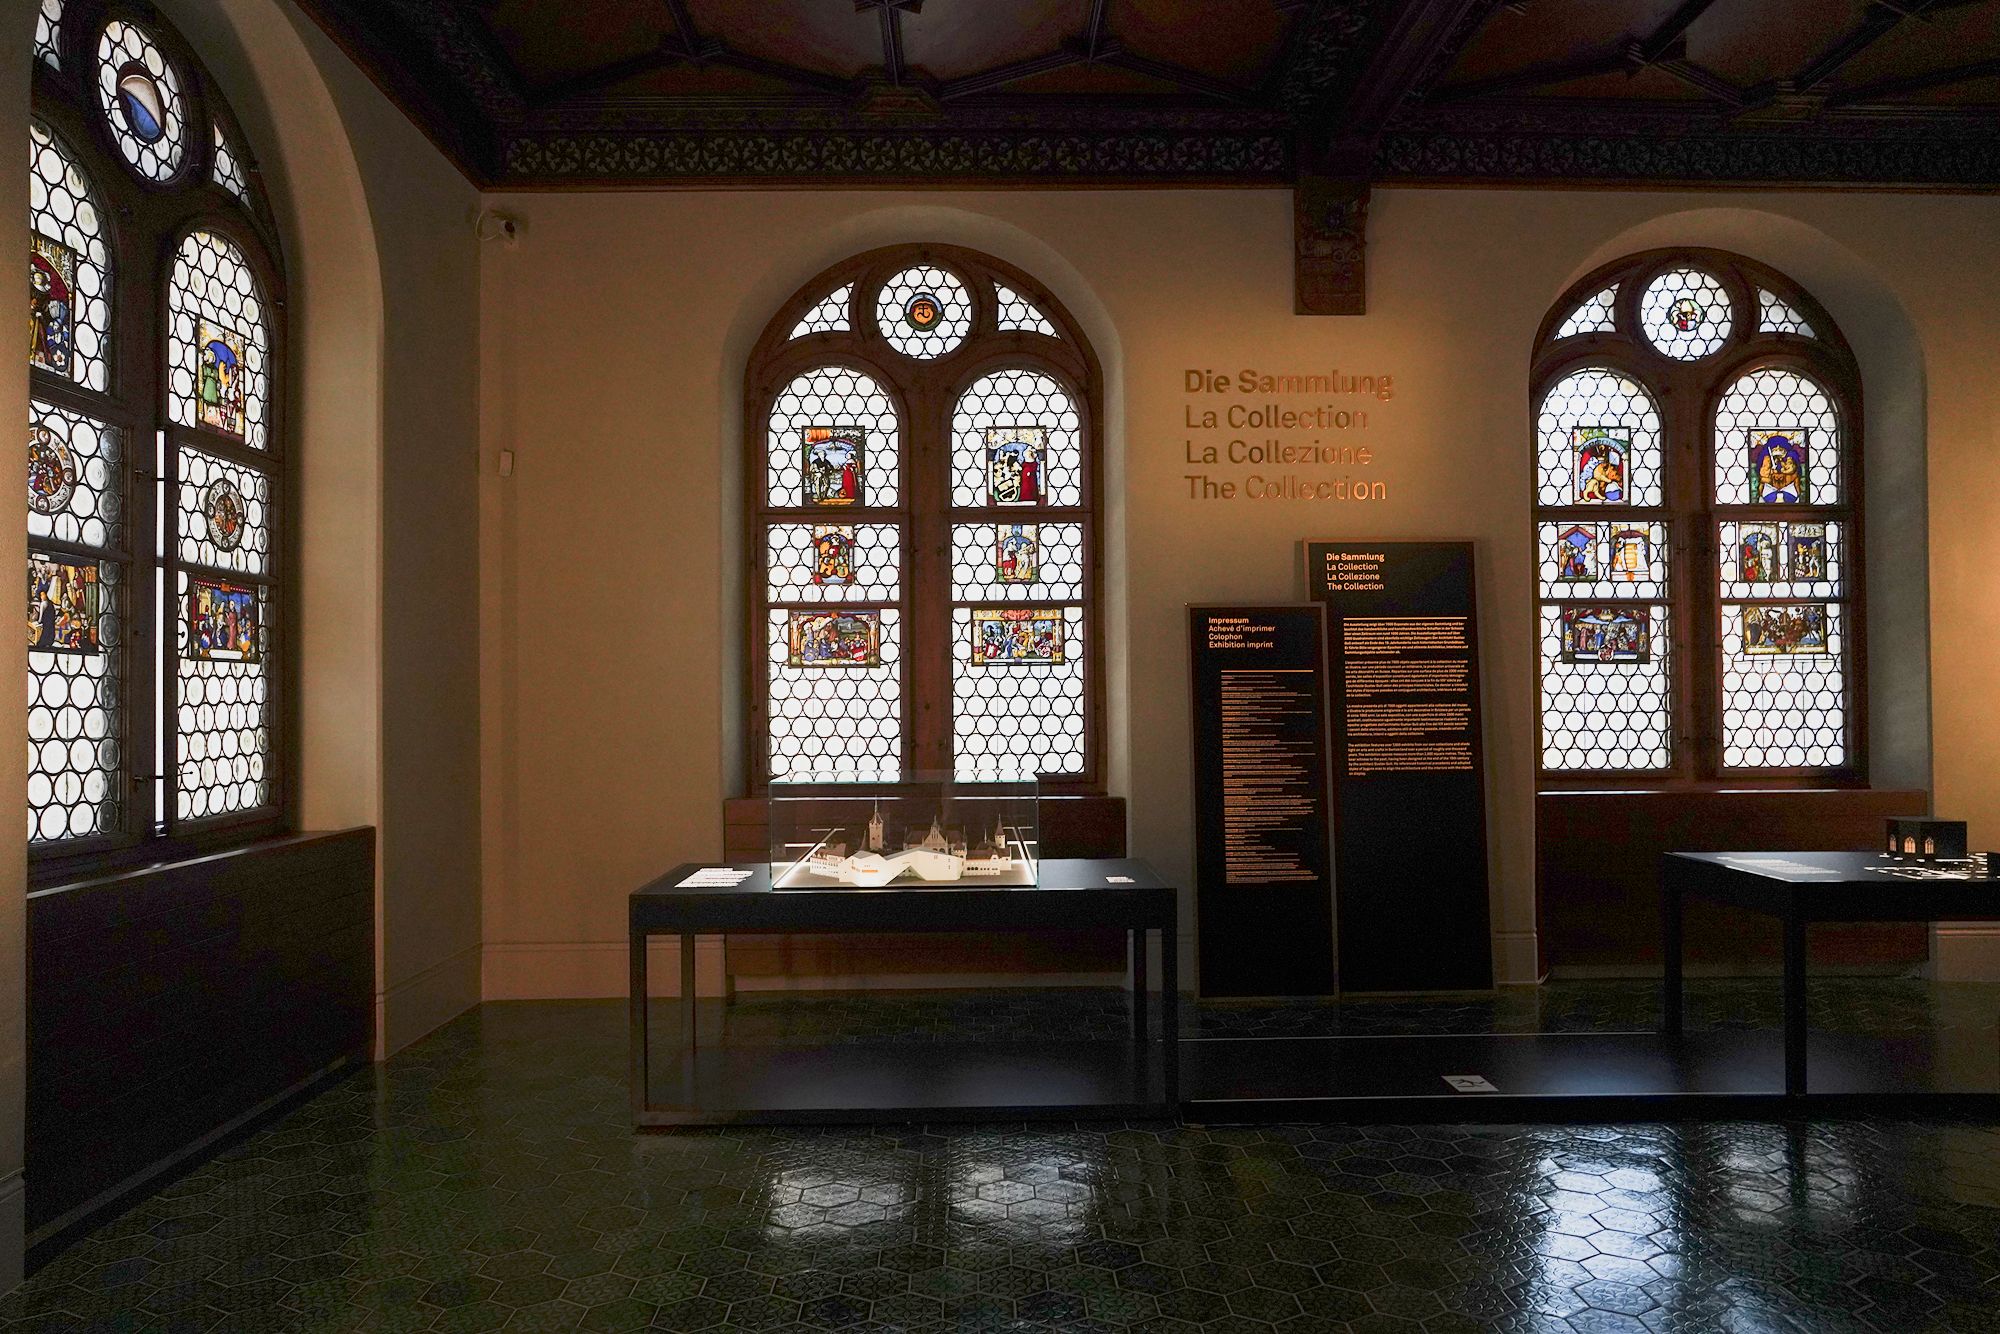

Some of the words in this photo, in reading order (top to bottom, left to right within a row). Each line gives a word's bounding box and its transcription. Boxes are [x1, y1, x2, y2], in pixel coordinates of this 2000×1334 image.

[1184, 369, 1230, 393] Die
[1238, 369, 1394, 401] Sammlung
[1185, 405, 1218, 429] La
[1227, 404, 1368, 429] Collection
[1186, 440, 1218, 464] La
[1228, 439, 1373, 464] Collezione
[1184, 475, 1236, 500] The
[1245, 475, 1386, 500] Collection
[1326, 553, 1340, 561] Die
[1341, 553, 1384, 562] Sammlung
[1326, 563, 1336, 571] La
[1338, 563, 1378, 571] Collection
[1327, 582, 1342, 590] The
[1343, 582, 1384, 590] Collection
[1208, 633, 1243, 641] Colophon
